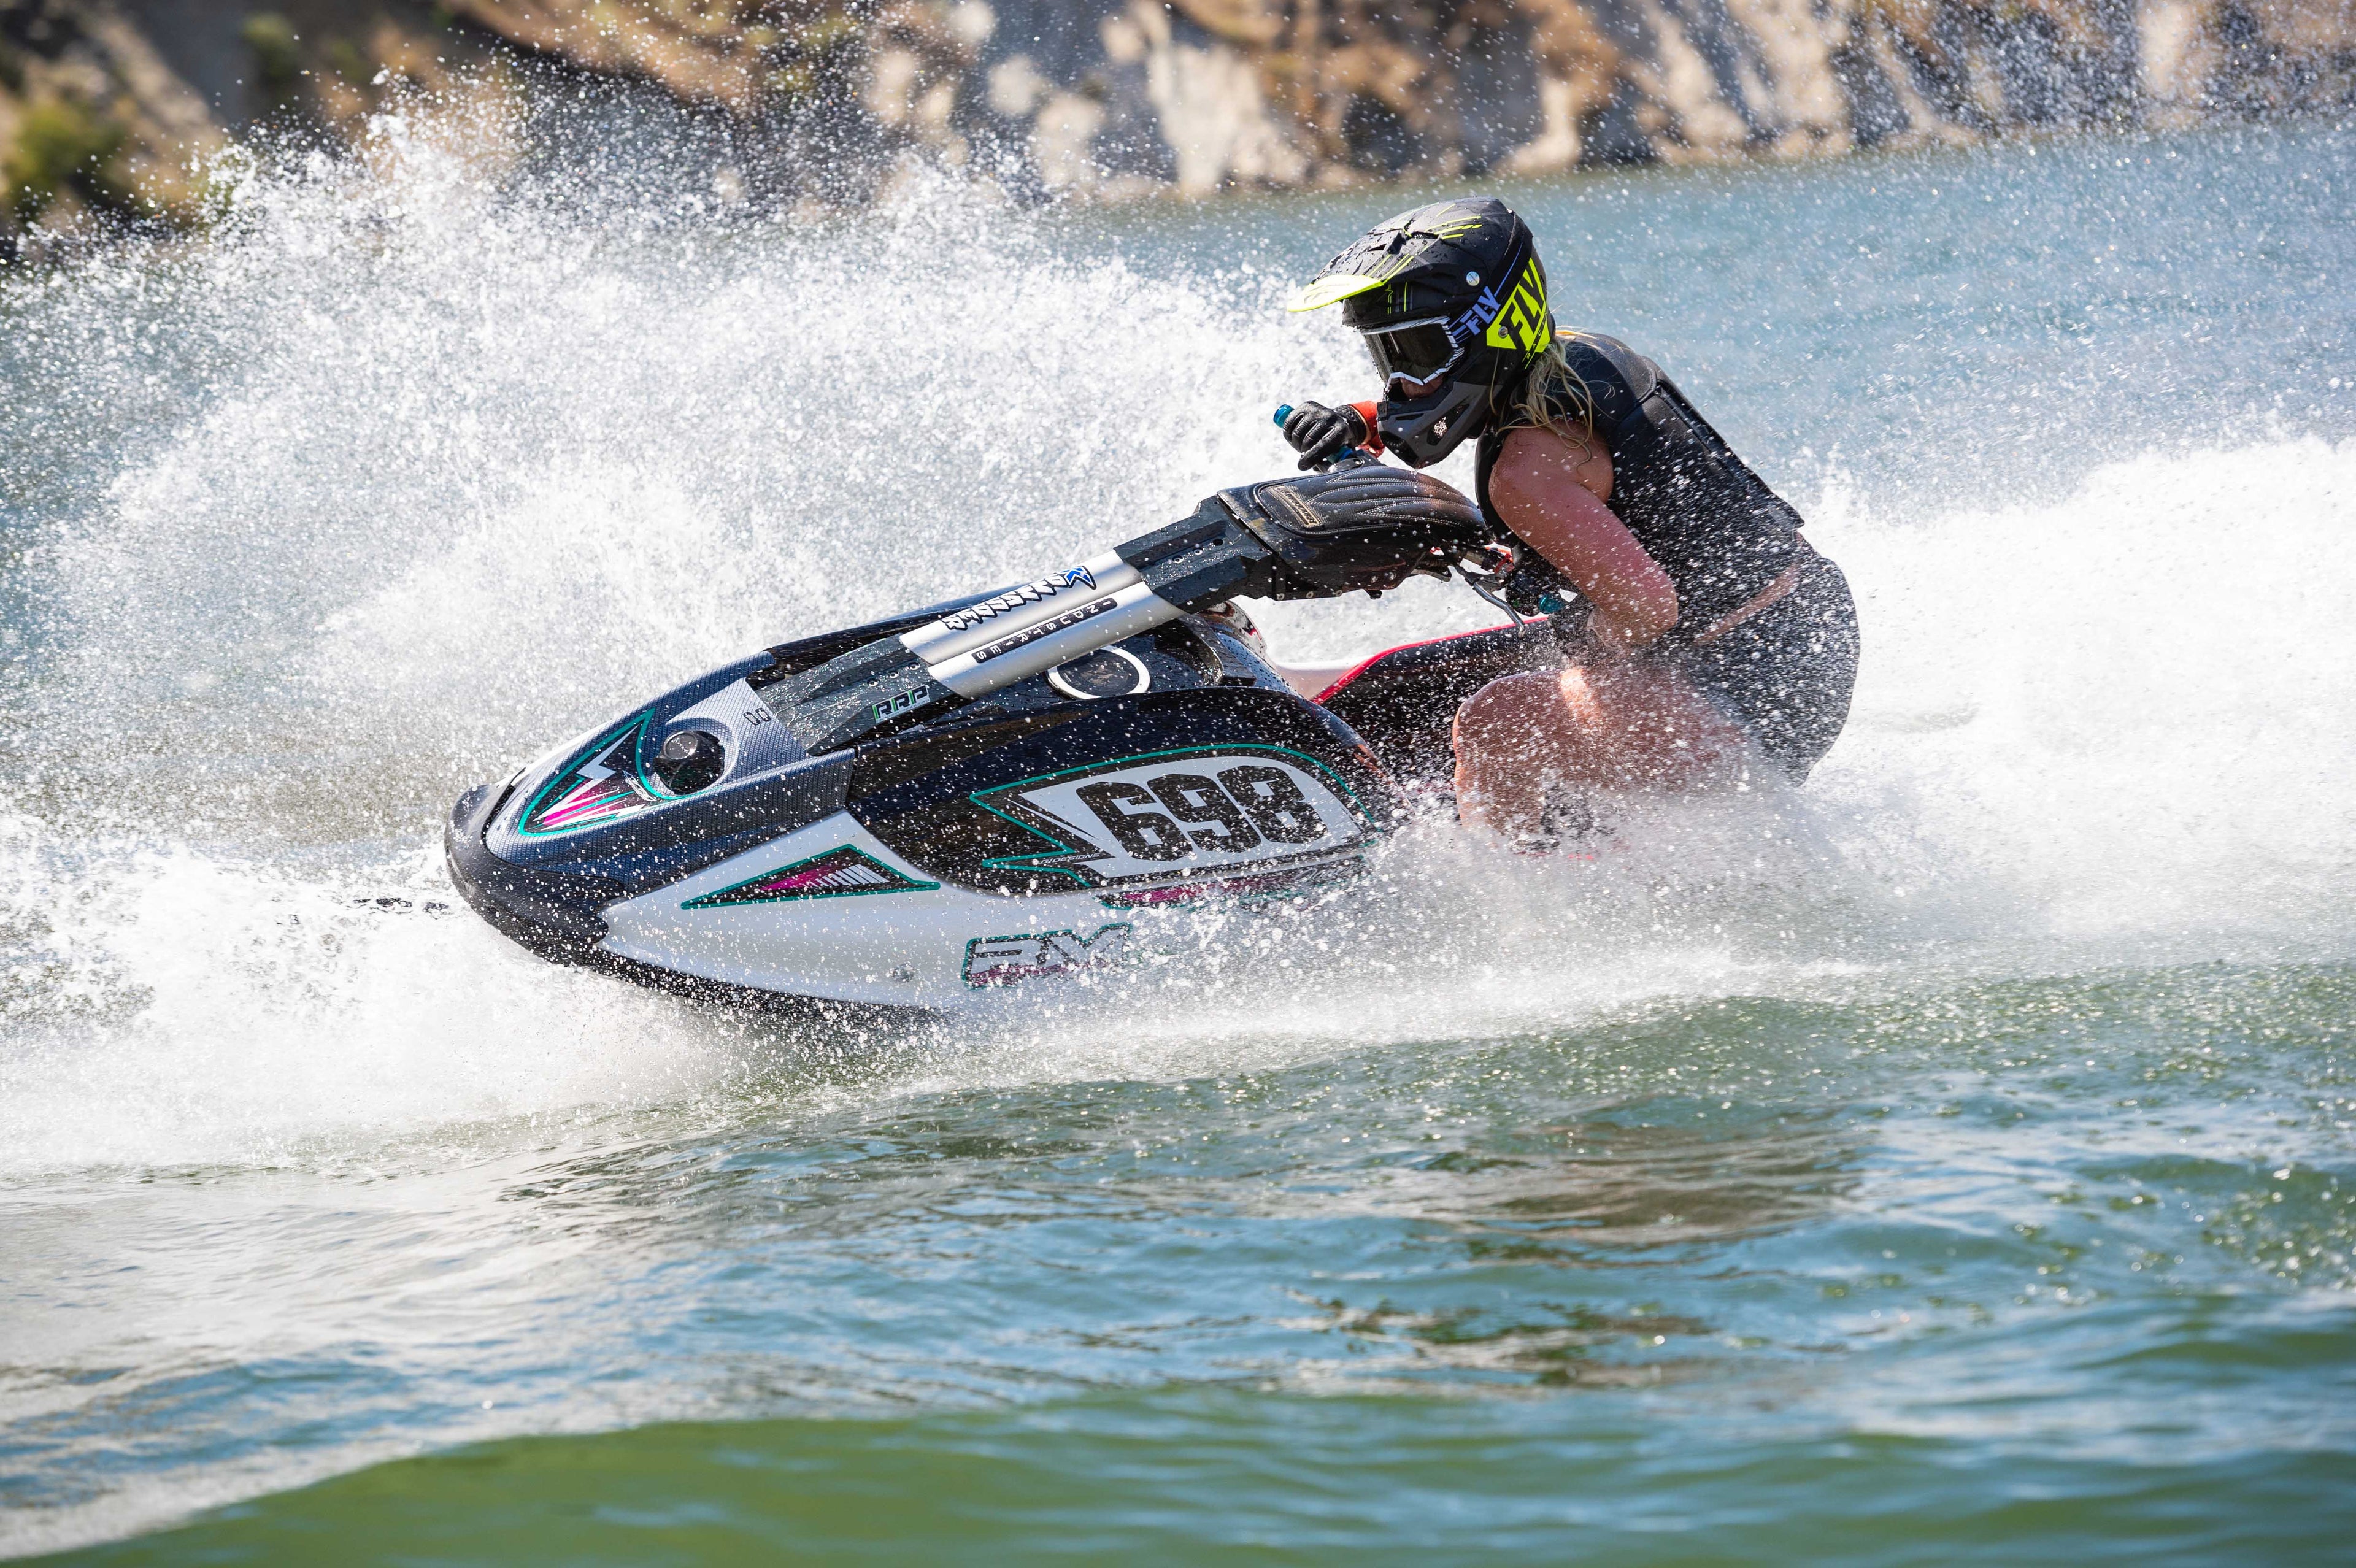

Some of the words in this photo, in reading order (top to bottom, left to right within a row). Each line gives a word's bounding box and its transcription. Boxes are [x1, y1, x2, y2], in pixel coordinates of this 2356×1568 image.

[1465, 286, 1501, 336] FLY
[1500, 267, 1546, 352] FLY
[976, 601, 1112, 660] INDUSTRIES
[872, 685, 930, 720] RRP
[1076, 765, 1328, 862] 698
